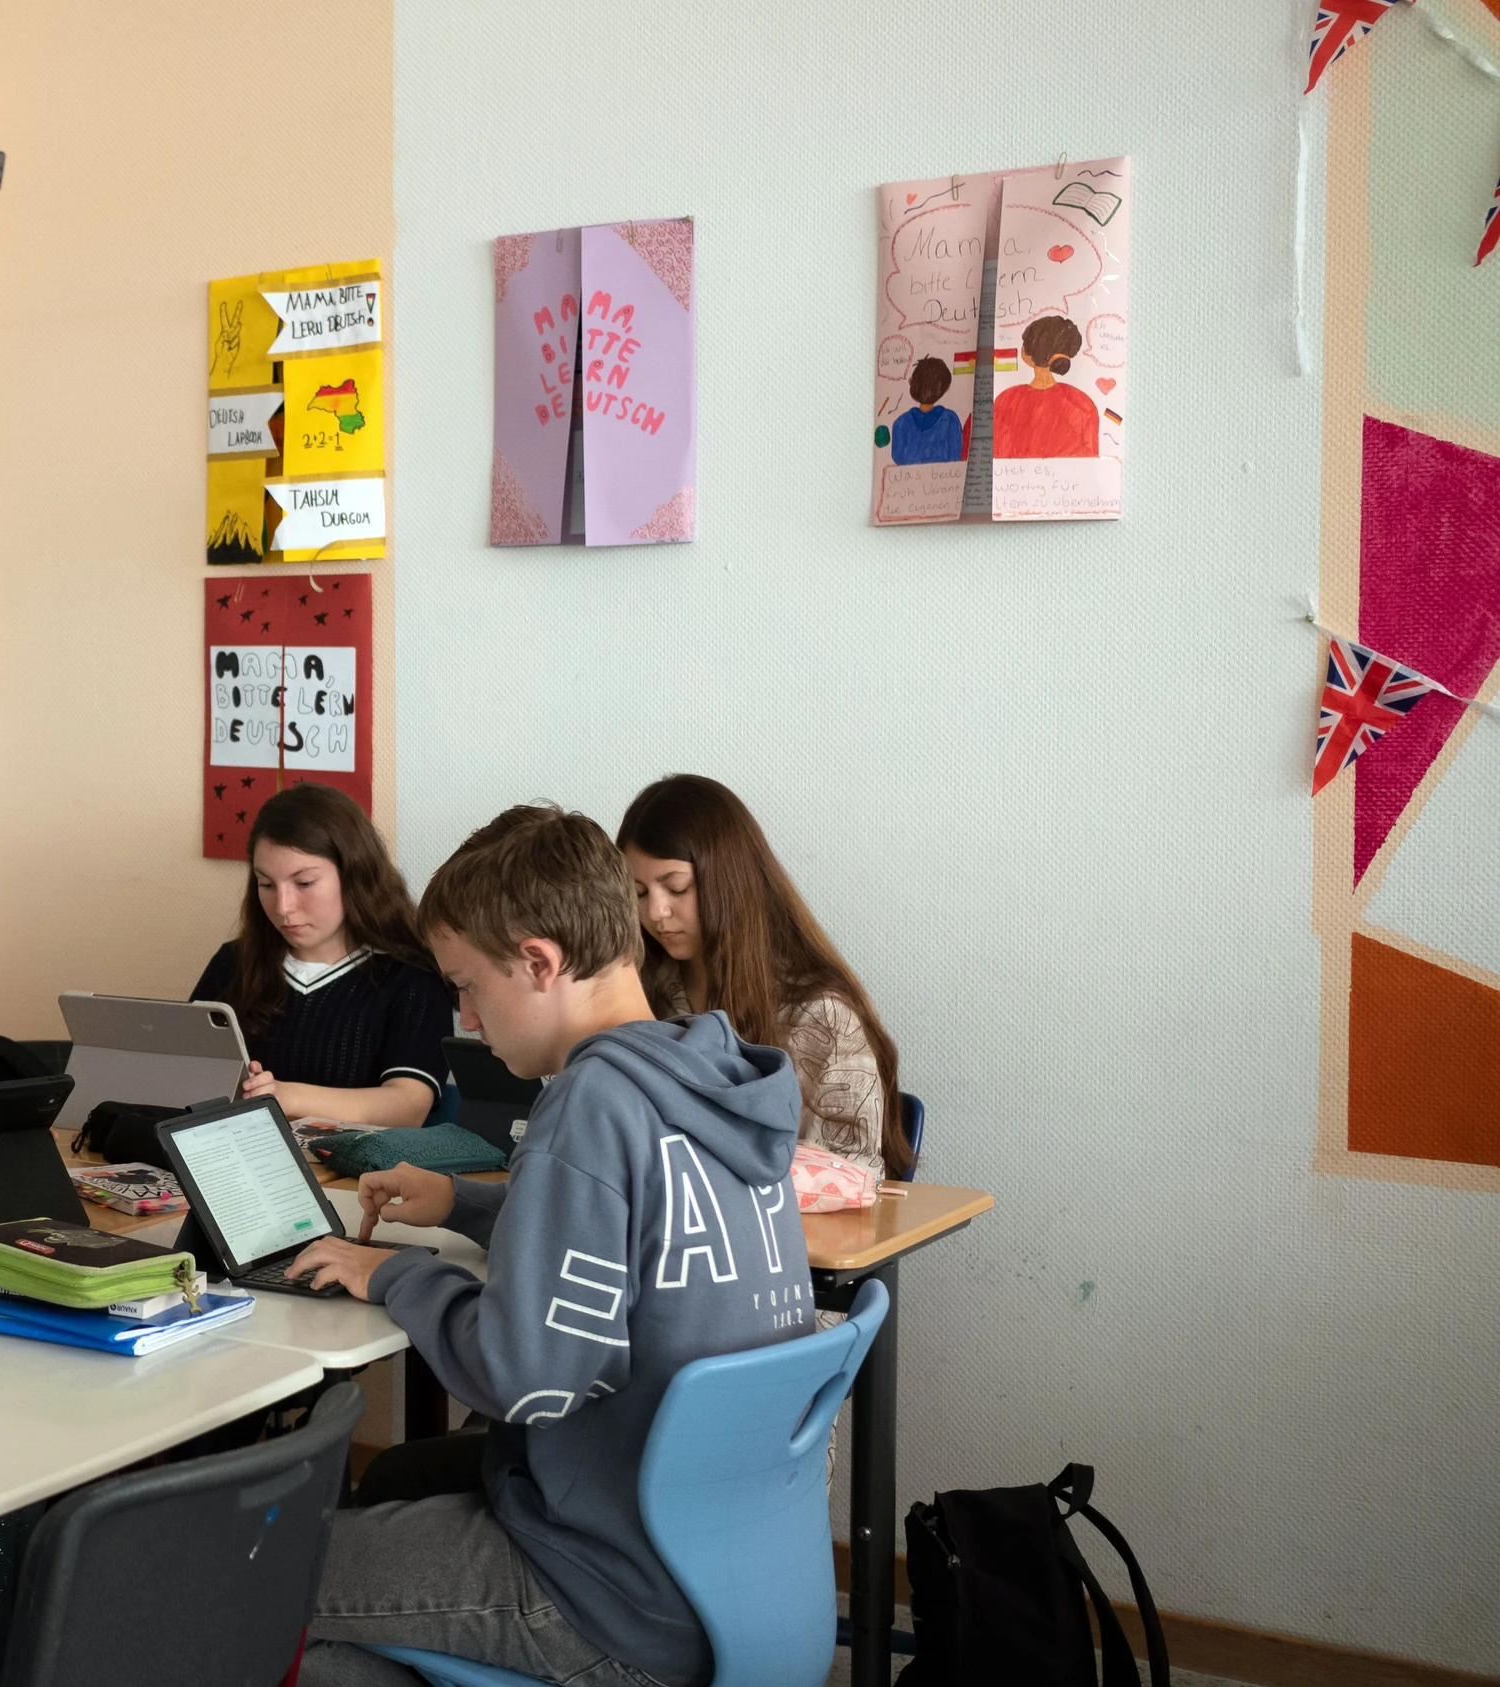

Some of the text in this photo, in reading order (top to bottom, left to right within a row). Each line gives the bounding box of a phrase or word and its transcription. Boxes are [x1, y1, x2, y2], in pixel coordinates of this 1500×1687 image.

[904, 227, 1031, 262] Mama,
[339, 285, 363, 304] BITTE
[910, 271, 951, 295] bitte
[923, 290, 1033, 323] Deutsch
[291, 321, 322, 339] LERN
[541, 328, 641, 364] BITTE
[540, 359, 630, 394] LERN
[534, 391, 665, 435] DEUTSCH
[215, 684, 355, 716] BITTE LERN
[213, 718, 348, 758] DEUTSCH
[116, 1304, 137, 1314] KNAUR
